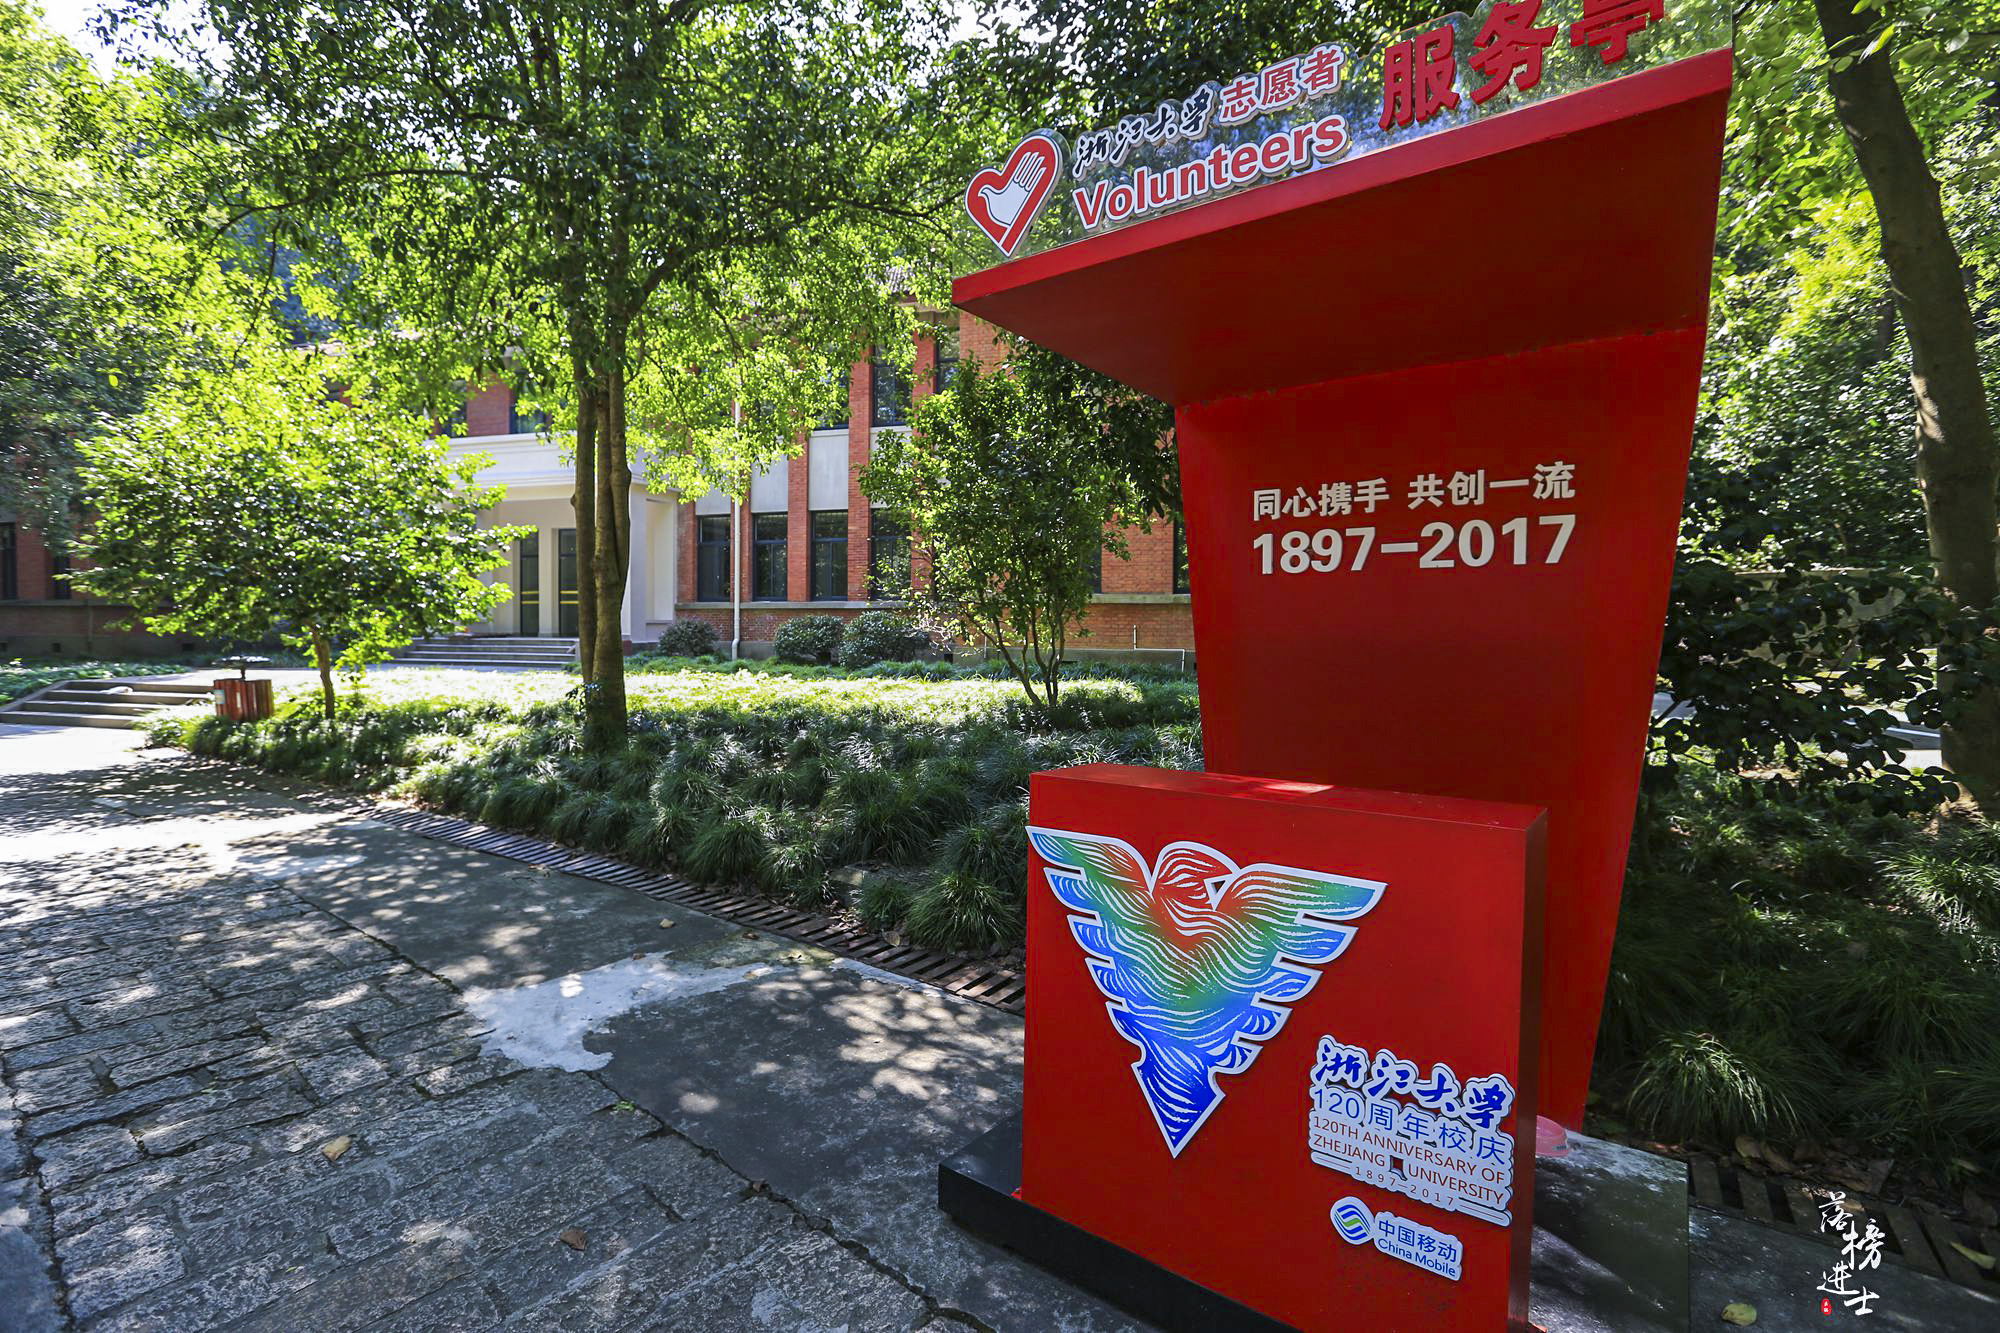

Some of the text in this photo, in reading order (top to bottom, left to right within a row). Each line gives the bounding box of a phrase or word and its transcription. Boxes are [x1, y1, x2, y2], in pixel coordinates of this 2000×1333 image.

[1073, 49, 1341, 175] 浙江大学 志愿者
[1075, 118, 1344, 227] Volunteers
[1253, 461, 1576, 521] 同心携手 共创一流
[1316, 1044, 1506, 1129] 浙江大学
[1314, 1088, 1506, 1166] 120周年校庆
[1314, 1116, 1505, 1185] 120TH ANNIVERSARY OF
[1313, 1133, 1505, 1206] ZHEJIANG UNIVERSITY
[1377, 1238, 1456, 1277] China Mobile
[1378, 1220, 1457, 1263] 中国移动
